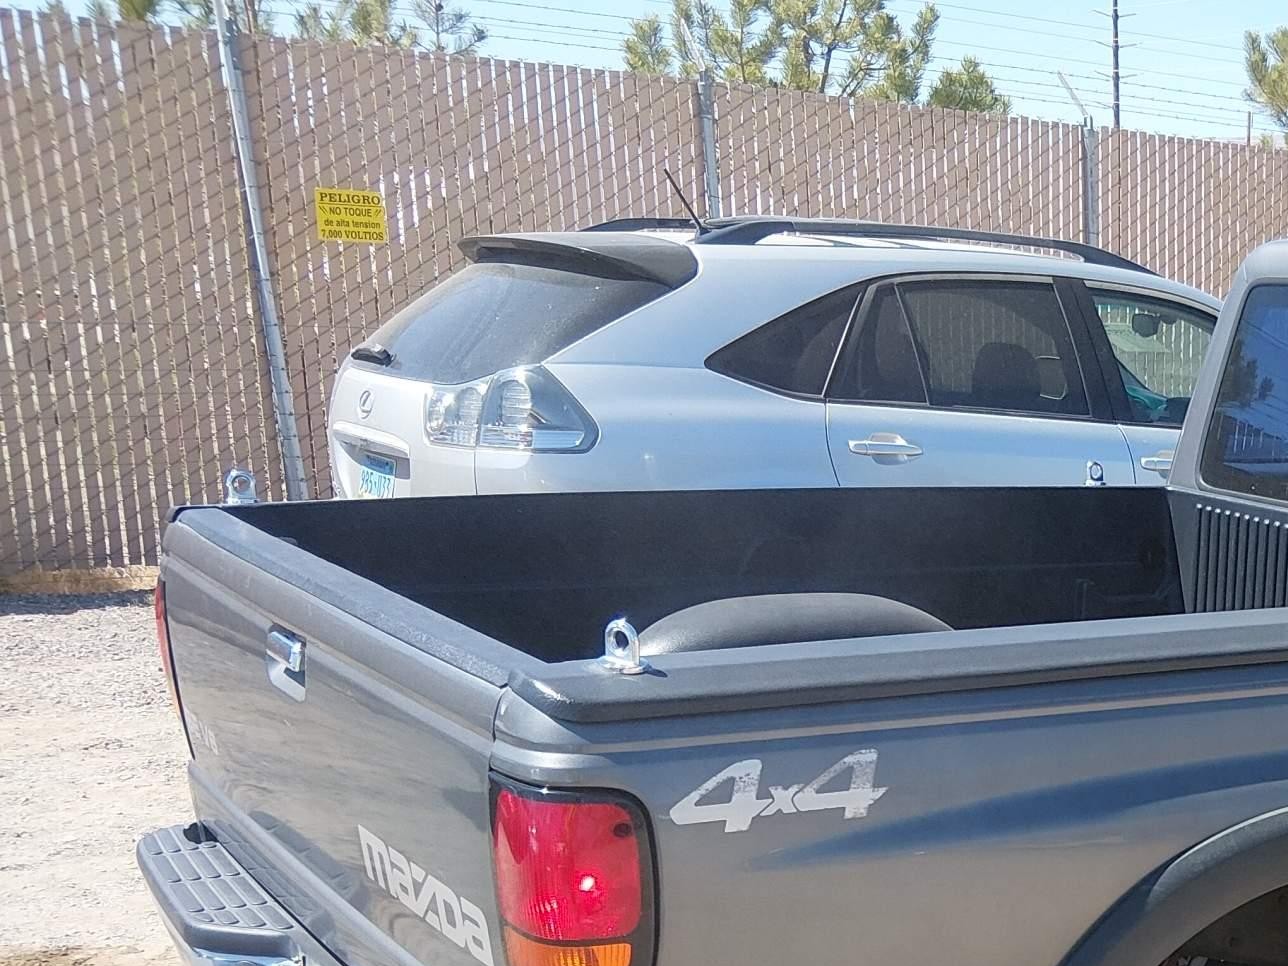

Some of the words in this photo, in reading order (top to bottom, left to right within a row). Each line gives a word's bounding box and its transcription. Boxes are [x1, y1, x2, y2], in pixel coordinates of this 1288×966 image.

[319, 192, 381, 205] PELIGRO
[329, 206, 342, 216] NO
[343, 207, 372, 217] TOQUE
[324, 218, 334, 227] de
[336, 219, 350, 228] alta
[352, 219, 381, 229] tension
[321, 229, 343, 239] 7,000
[344, 230, 384, 241] VOLTIOS
[669, 748, 889, 833] 4x4
